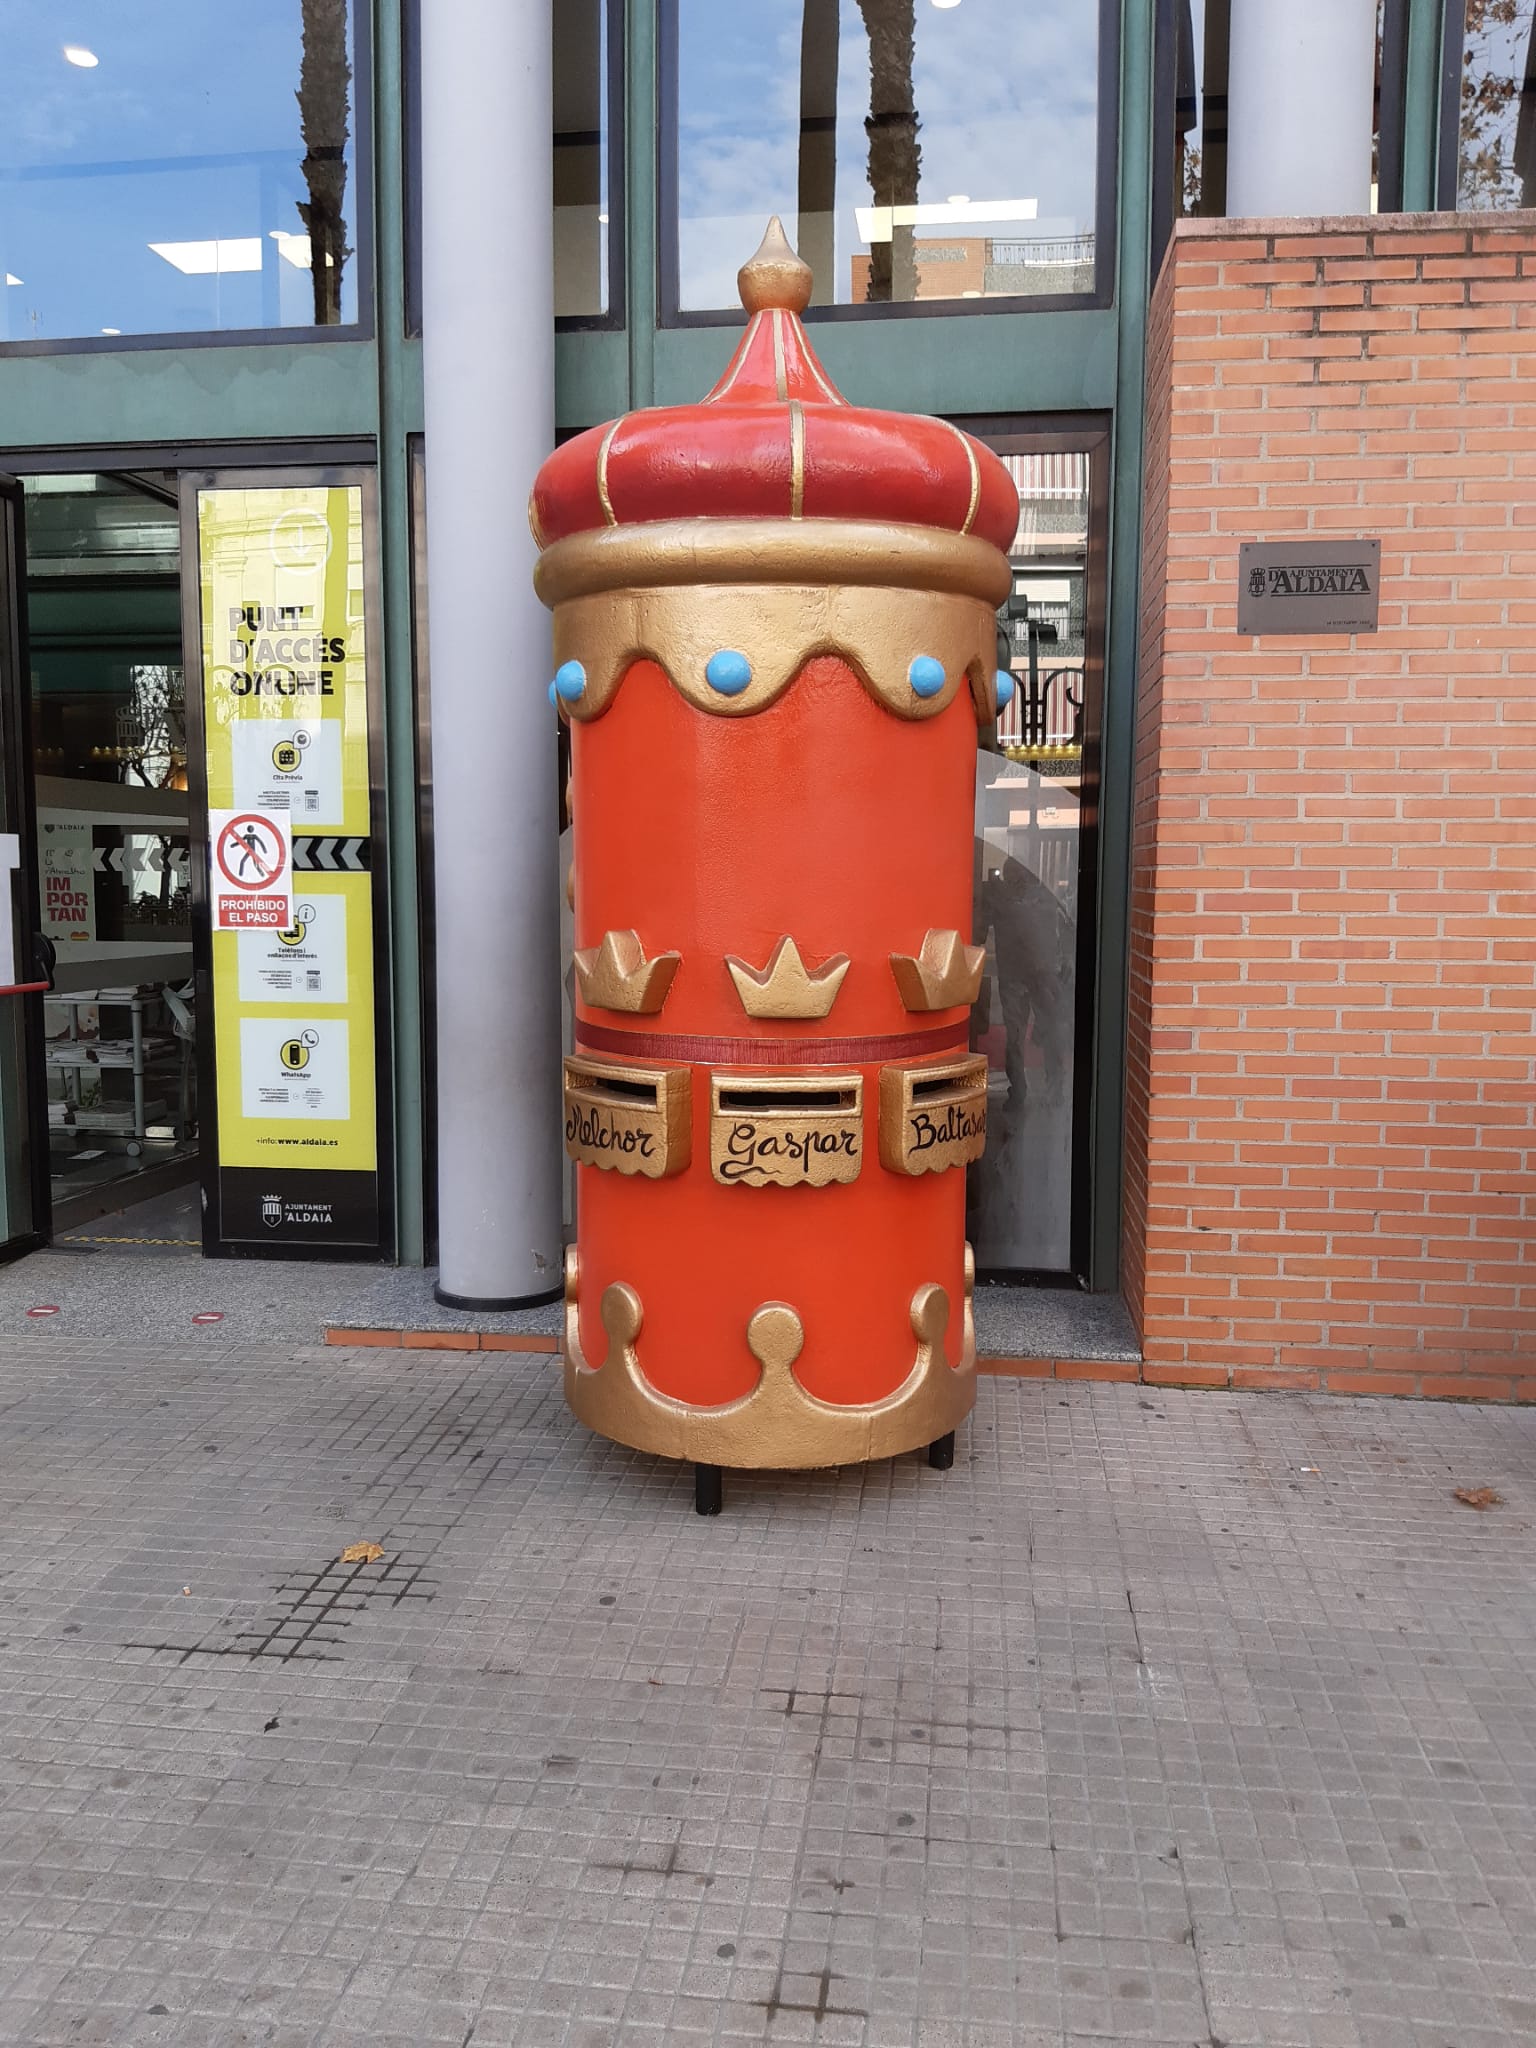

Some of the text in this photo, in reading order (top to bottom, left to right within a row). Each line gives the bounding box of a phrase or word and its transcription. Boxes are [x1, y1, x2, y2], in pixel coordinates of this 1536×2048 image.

[1290, 568, 1355, 577] AJUNTAMENT
[229, 606, 304, 631] PUNT
[230, 671, 334, 696] ONLINE
[46, 877, 71, 891] IM
[46, 892, 88, 907] POR
[221, 900, 286, 911] PROHIBIDO
[229, 913, 279, 923] EL PASO
[278, 1138, 338, 1146] www.aldaia.es
[720, 1122, 859, 1178] Gaspar
[285, 1203, 332, 1211] AJUNTAMENT
